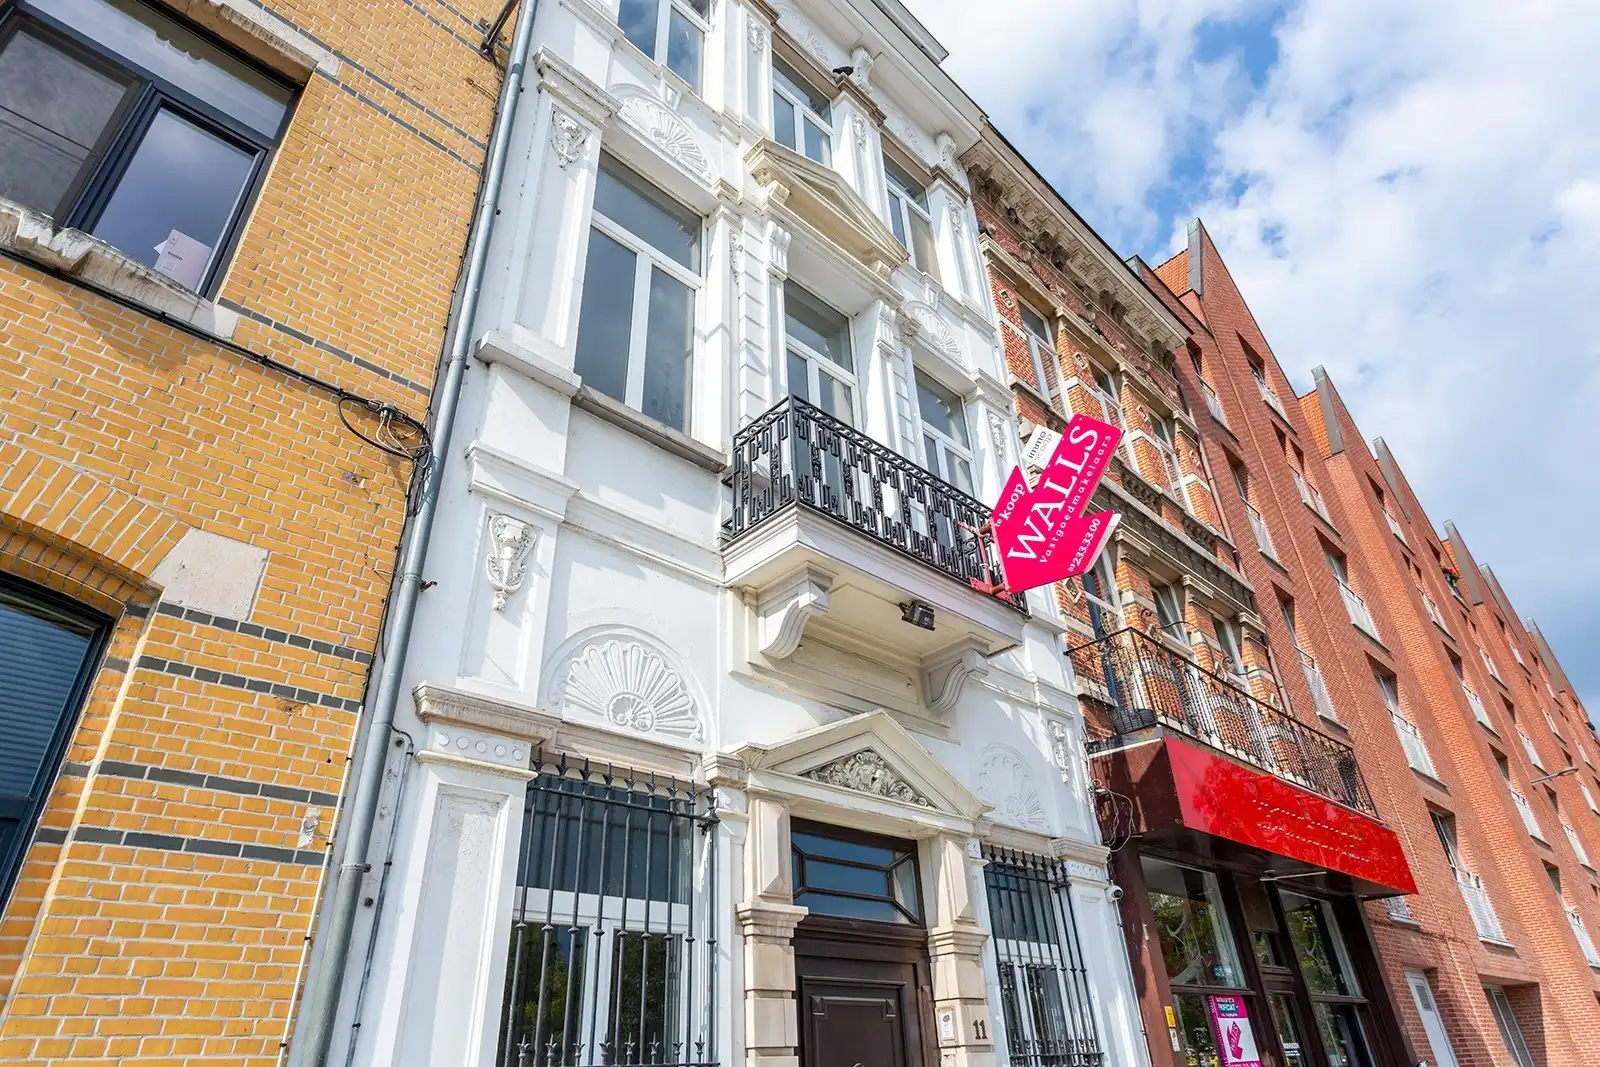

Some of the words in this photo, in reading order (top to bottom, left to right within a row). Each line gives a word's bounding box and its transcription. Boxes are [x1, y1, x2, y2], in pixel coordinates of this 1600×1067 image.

[1027, 431, 1047, 459] immo
[1035, 433, 1053, 461] scoop
[999, 483, 1026, 520] koop
[1007, 425, 1099, 560] WALLS
[1039, 435, 1112, 563] Vastgoedmakelaars
[972, 1019, 988, 1040] 11
